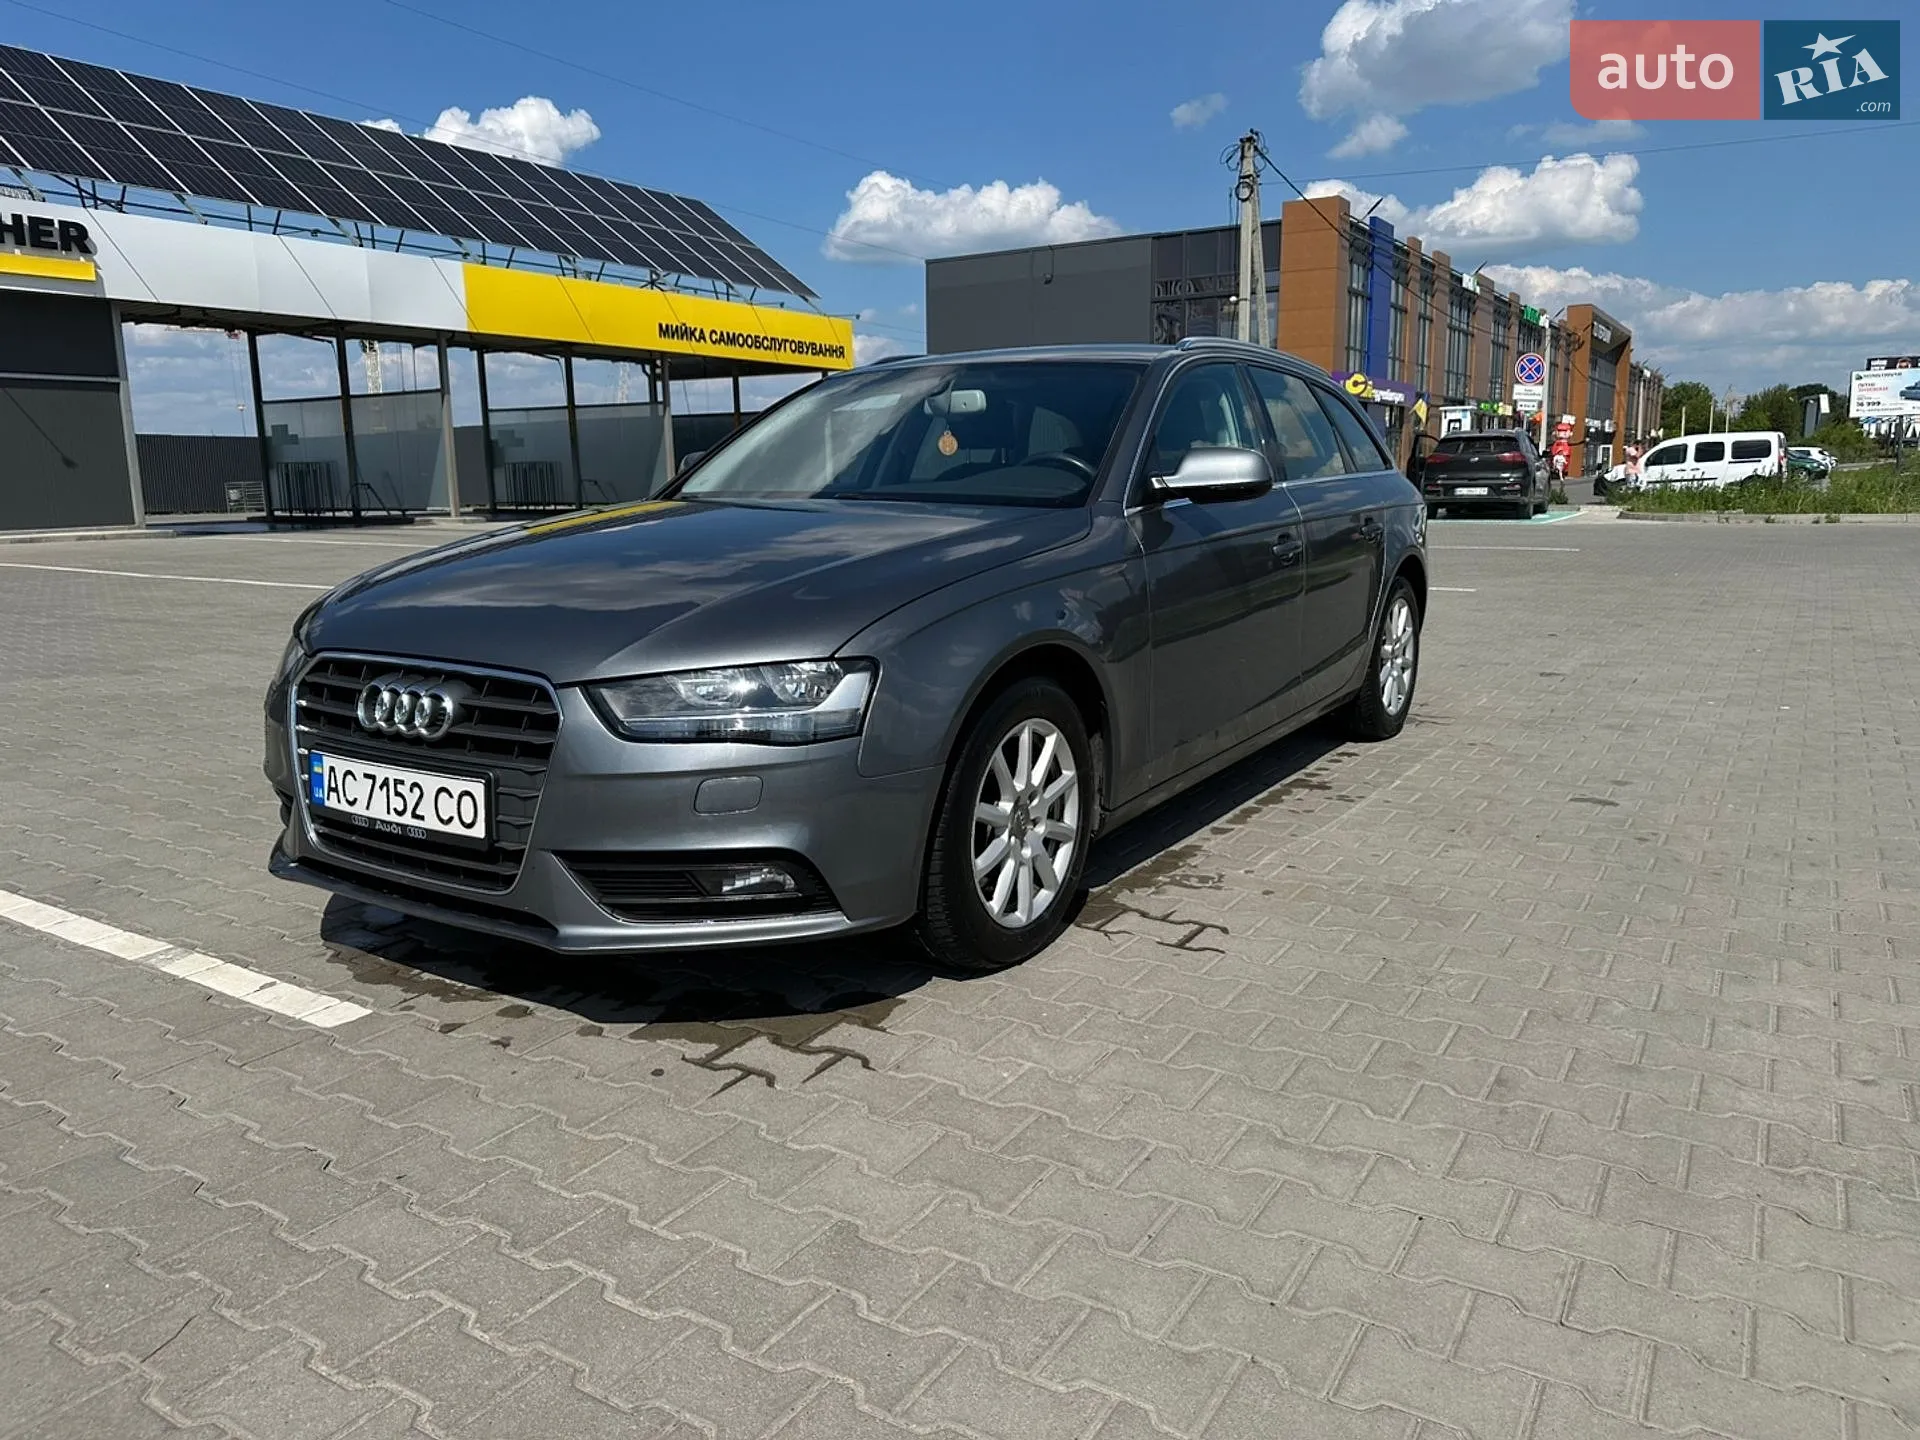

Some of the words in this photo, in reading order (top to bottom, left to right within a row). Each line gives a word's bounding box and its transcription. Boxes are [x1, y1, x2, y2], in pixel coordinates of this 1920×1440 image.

[658, 322, 706, 344] МИЙКА
[709, 329, 845, 360] САМООБСЛУГОВУВАННЯ
[313, 786, 323, 799] UA
[434, 786, 479, 829] CO
[375, 821, 402, 836] Audi
